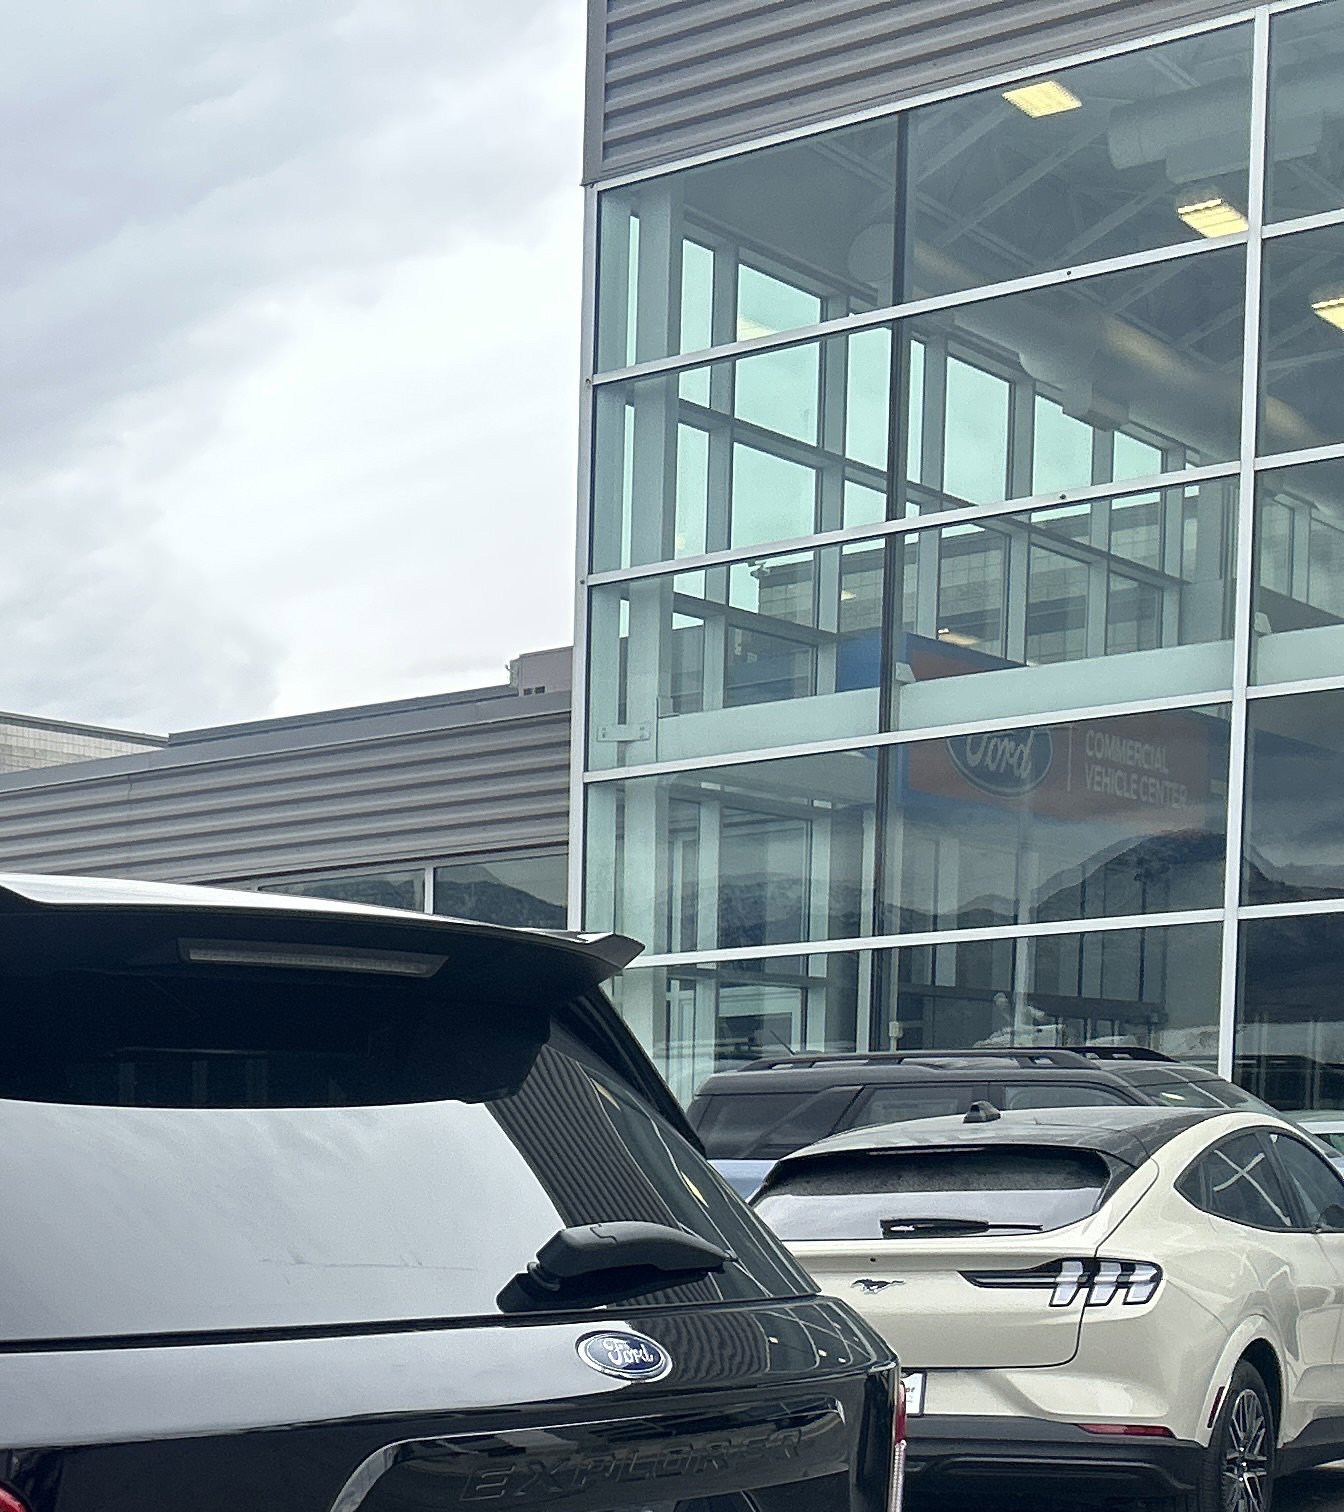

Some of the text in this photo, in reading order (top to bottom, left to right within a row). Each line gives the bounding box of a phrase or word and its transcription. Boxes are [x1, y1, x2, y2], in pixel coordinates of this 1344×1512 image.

[1085, 730, 1169, 774] COMMERCIAL
[1084, 763, 1188, 809] VEHICLE CENTER
[602, 1337, 654, 1366] Ford
[458, 1429, 801, 1502] EXPLORER
